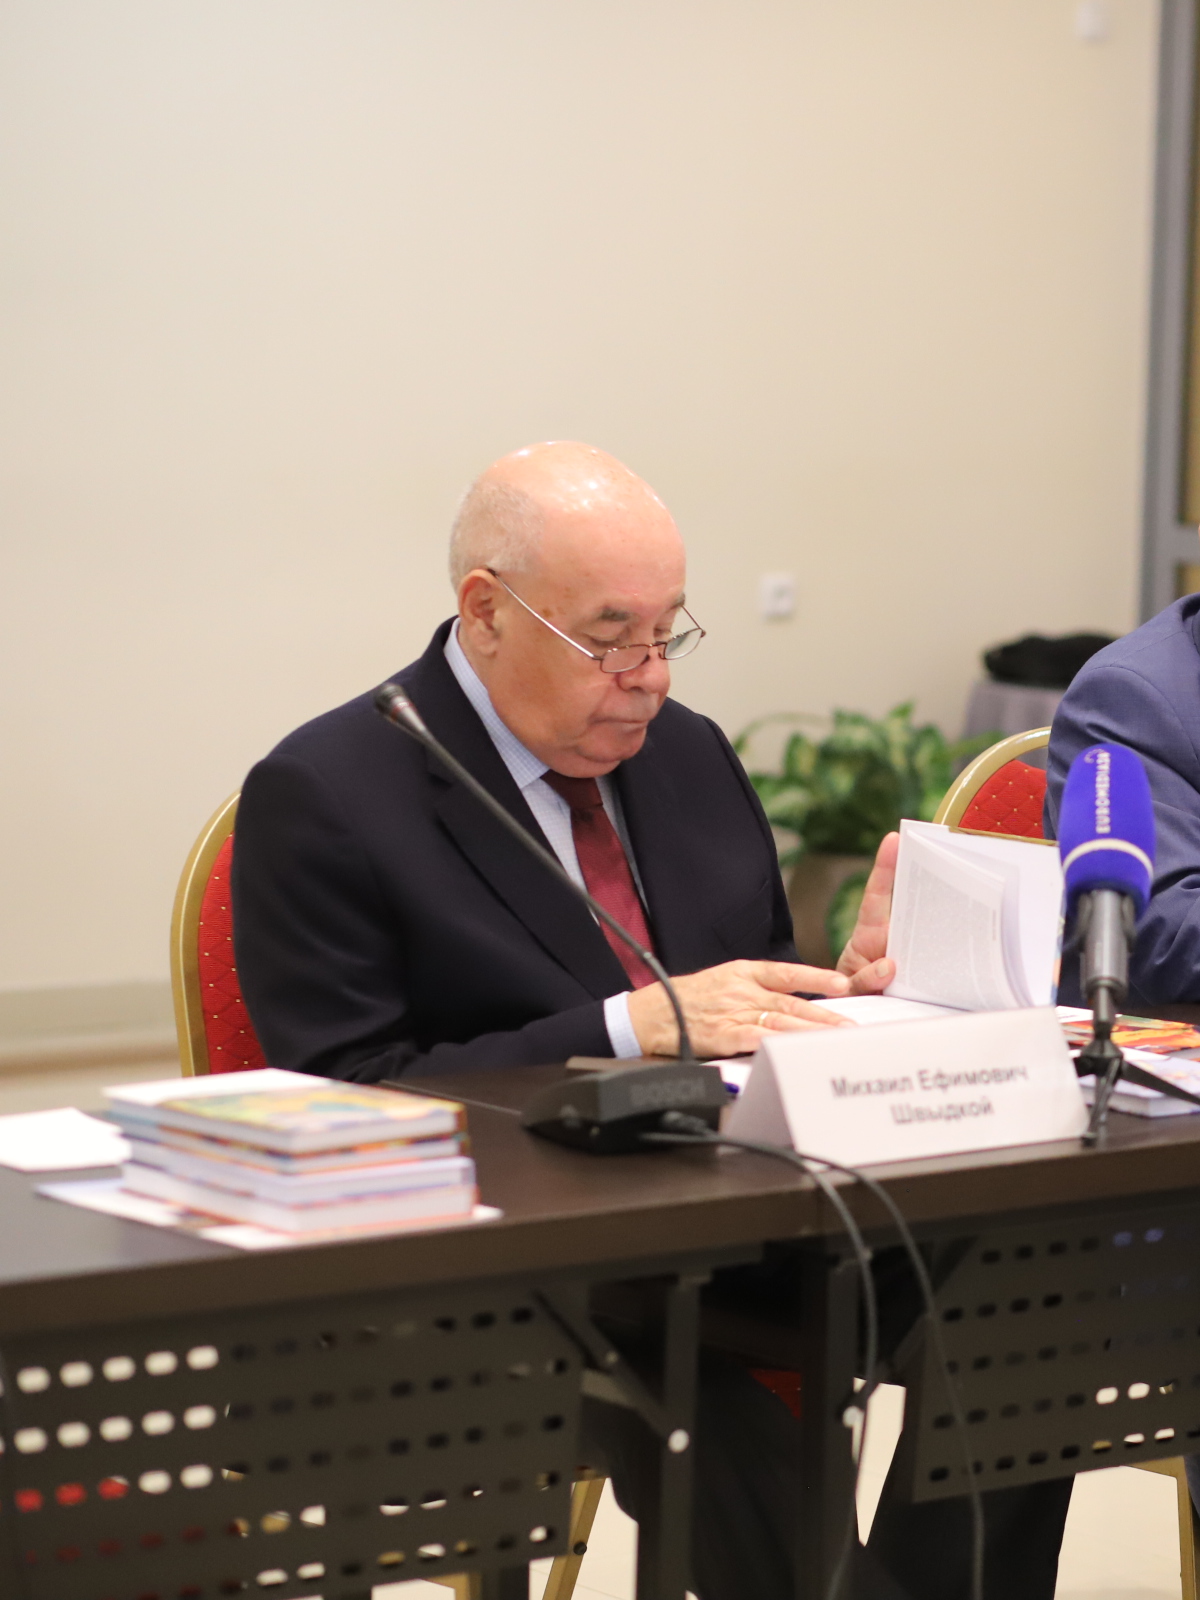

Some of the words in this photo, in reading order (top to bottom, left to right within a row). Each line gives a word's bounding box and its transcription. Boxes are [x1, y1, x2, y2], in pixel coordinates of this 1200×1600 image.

[830, 1077, 914, 1099] Михаил
[917, 1066, 1029, 1093] Ефимович
[890, 1096, 995, 1125] Швыдкой
